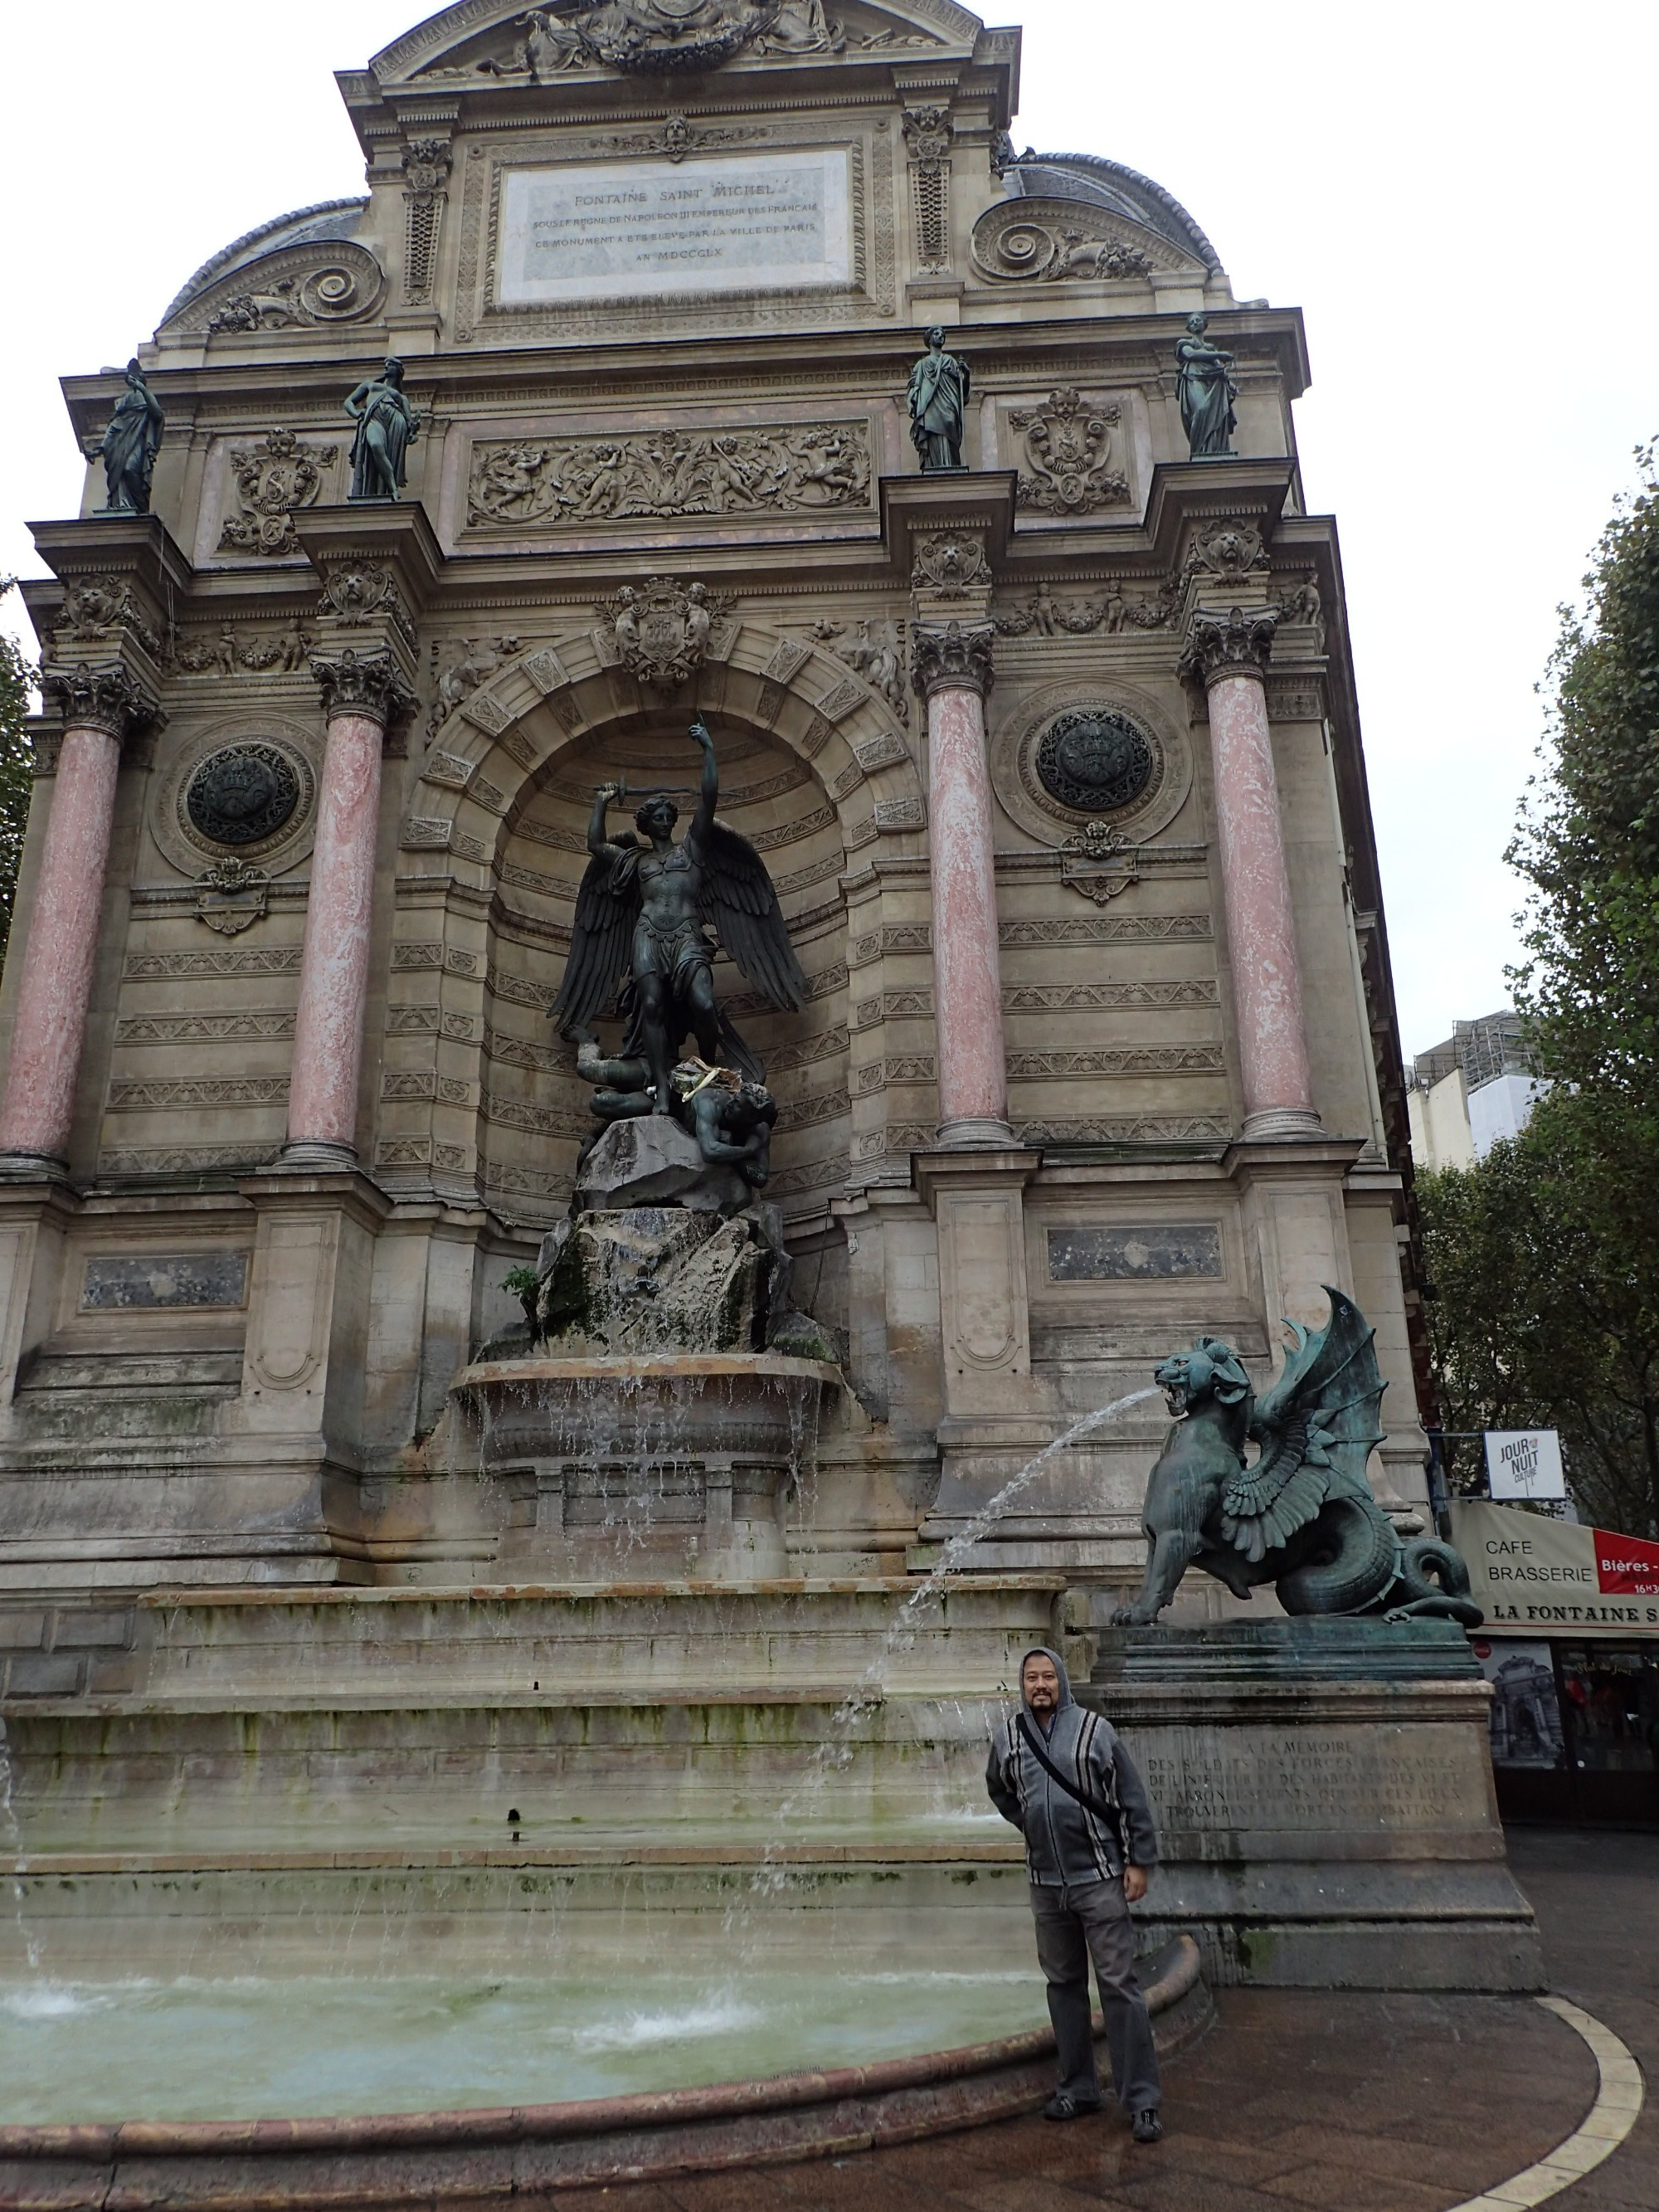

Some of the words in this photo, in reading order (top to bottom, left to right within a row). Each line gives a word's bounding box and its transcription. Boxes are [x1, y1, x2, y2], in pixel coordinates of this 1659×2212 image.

[575, 192, 648, 207] FONTAINE
[659, 189, 703, 201] SAINT
[713, 185, 775, 197] MICHEL
[533, 221, 558, 230] SOUS
[559, 220, 570, 228] LE
[609, 216, 621, 224] DE
[624, 212, 678, 222] NAPOLEON
[679, 210, 689, 220] III
[692, 208, 745, 218] EMPEREUR
[747, 207, 766, 215] DES
[535, 240, 548, 249] CE
[552, 236, 615, 247] MONUMENT
[688, 230, 710, 238] PAR
[729, 227, 761, 235] VILLE
[783, 222, 816, 232] PARIS
[636, 253, 651, 261] AN
[657, 247, 723, 261] MDCCCLX
[1501, 1438, 1530, 1464] JOUR
[1511, 1449, 1539, 1475] NUIT
[1514, 1467, 1537, 1484] CULTURE
[1486, 1541, 1534, 1555] CAFE
[1489, 1566, 1593, 1582] BRASSERIE
[1602, 1559, 1650, 1572] Bières
[1493, 1605, 1520, 1620] LA
[1527, 1605, 1640, 1623] FONTAINE
[1148, 1758, 1175, 1771] DES
[1150, 1774, 1165, 1786] DE
[1389, 1772, 1415, 1784] DES
